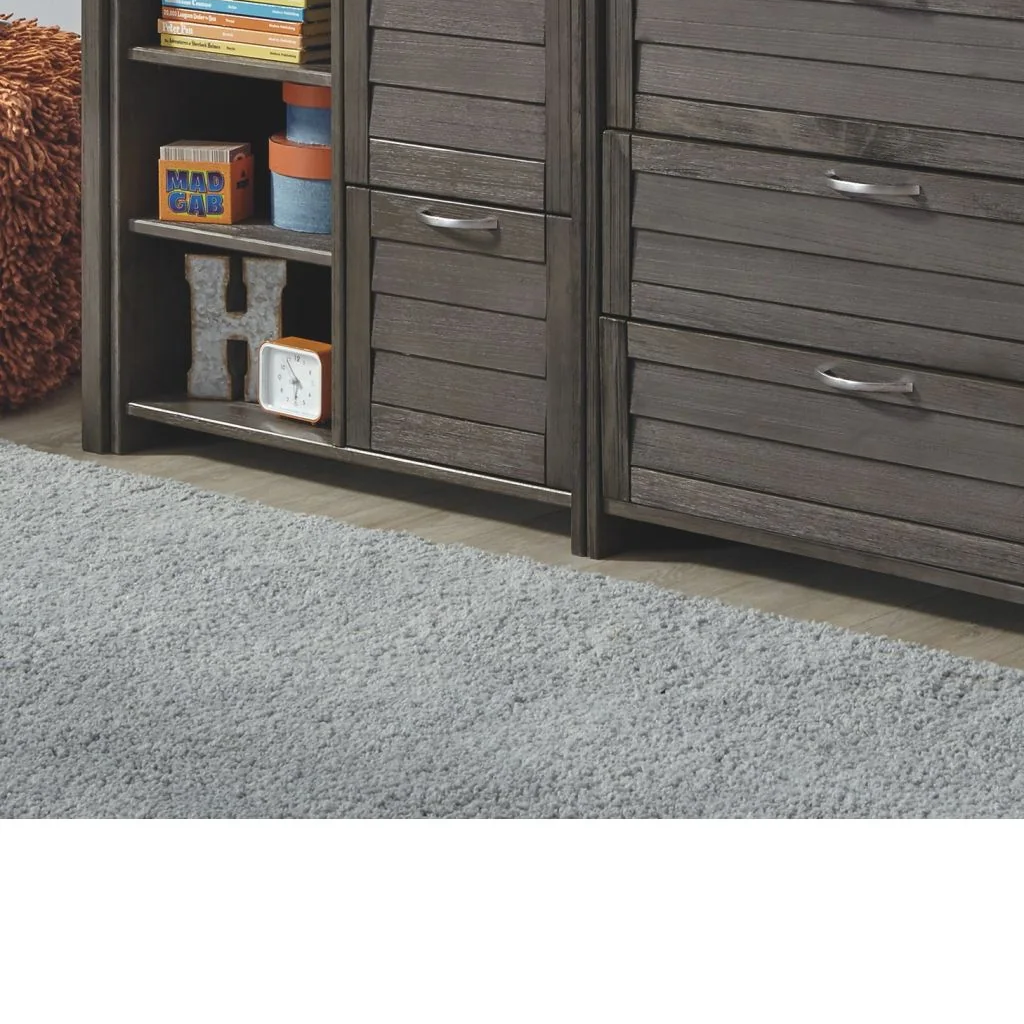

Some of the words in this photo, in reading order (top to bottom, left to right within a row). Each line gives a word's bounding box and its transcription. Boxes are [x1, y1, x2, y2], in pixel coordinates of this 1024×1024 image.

[166, 168, 225, 193] MAD
[168, 191, 225, 217] GAB
[185, 254, 287, 401] H
